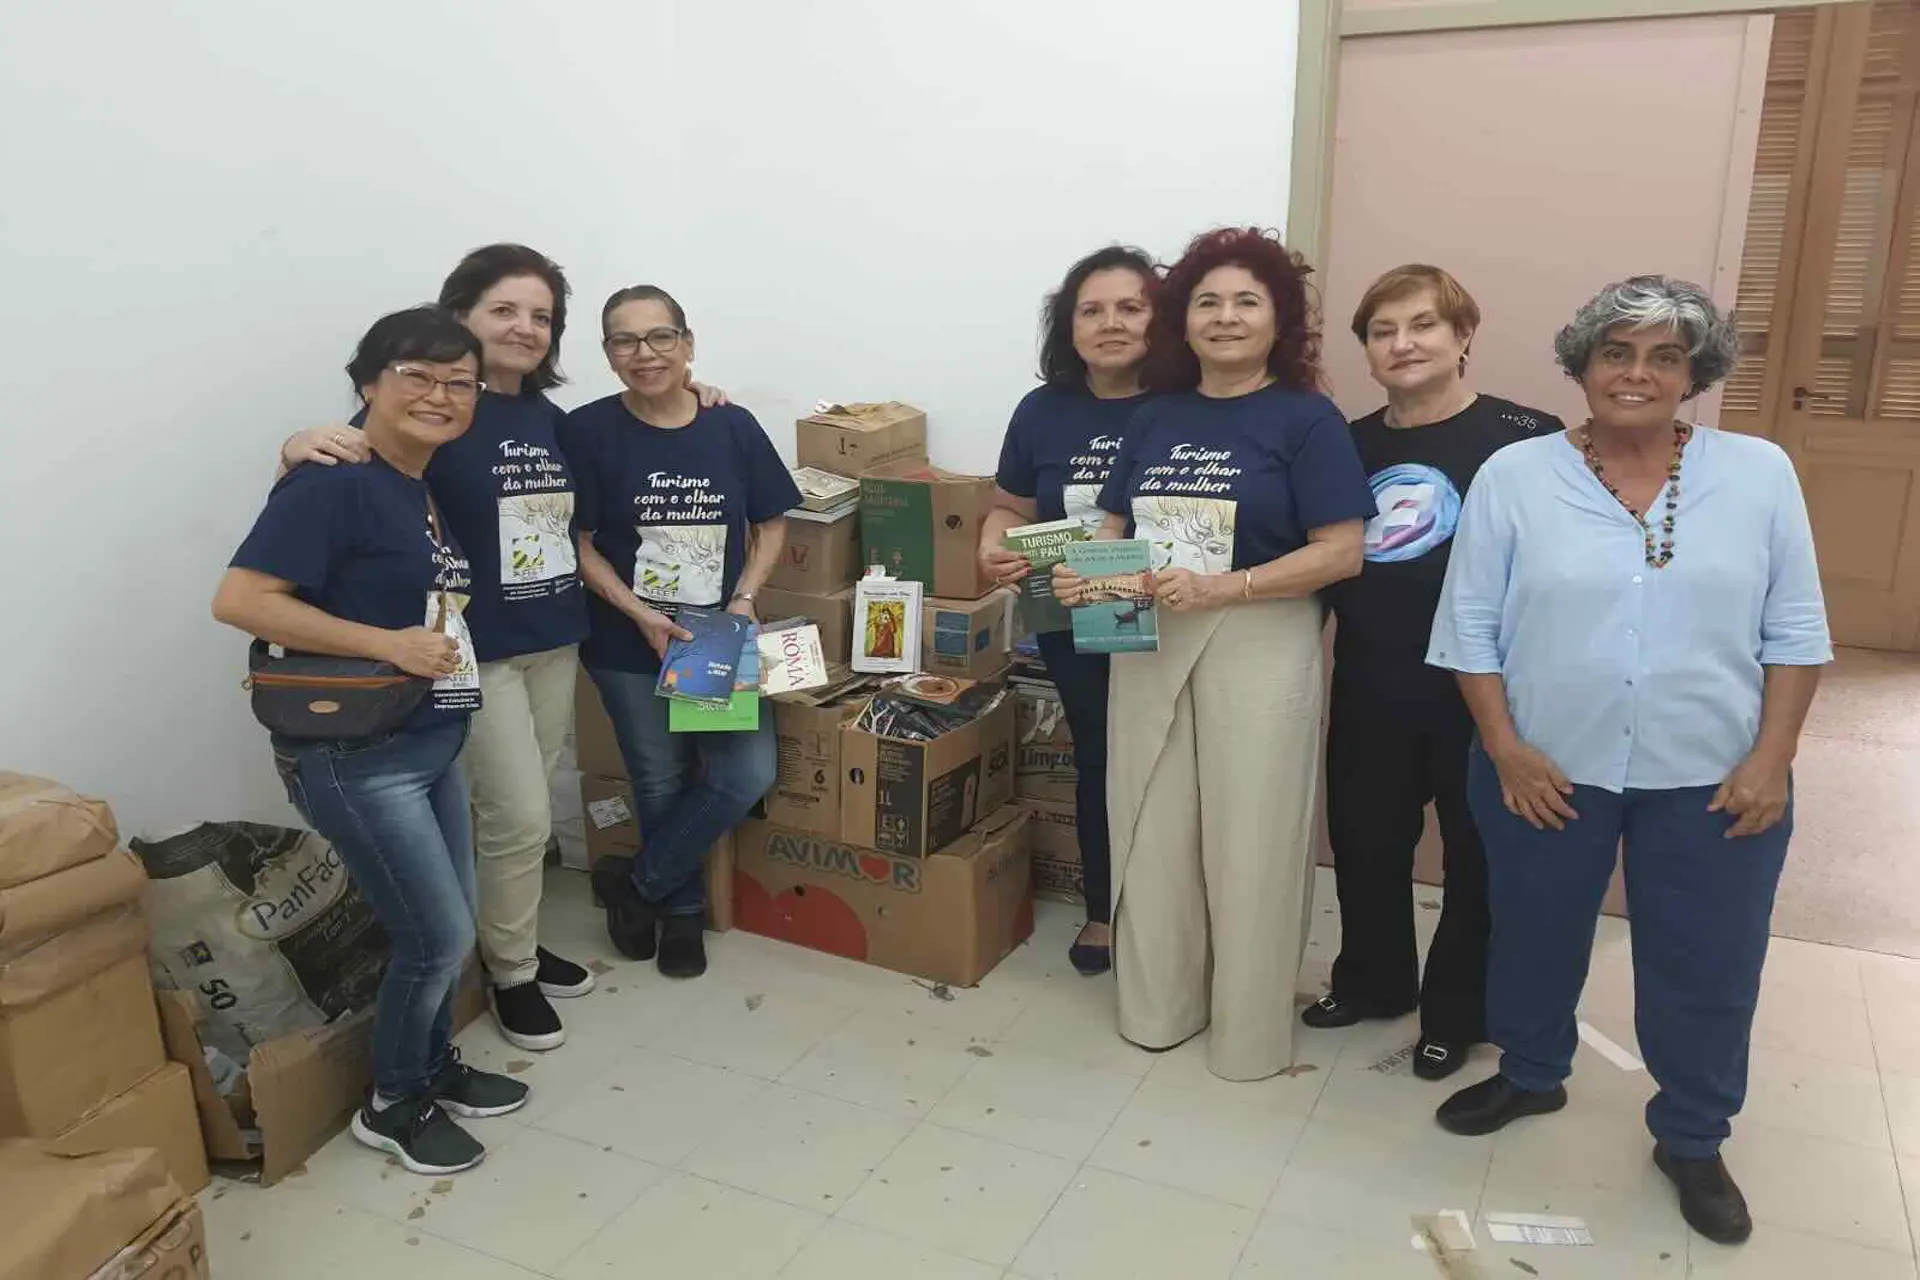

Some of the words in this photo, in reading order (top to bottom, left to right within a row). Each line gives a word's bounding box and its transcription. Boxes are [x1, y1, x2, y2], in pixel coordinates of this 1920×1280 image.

[1170, 443, 1231, 461] Turismo
[492, 464, 522, 475] com
[524, 463, 532, 472] o
[1070, 456, 1102, 466] com
[1144, 466, 1176, 476] com
[1179, 466, 1190, 475] o
[1193, 461, 1242, 477] olhar
[503, 477, 521, 490] da
[525, 472, 567, 489] mulher
[648, 472, 710, 488] Turismo
[1073, 466, 1096, 480] da
[1140, 477, 1162, 490] da
[1165, 476, 1231, 493] mulher
[634, 495, 668, 504] com
[671, 495, 679, 504] o
[684, 489, 725, 504] olhar
[640, 507, 663, 520] da
[667, 505, 722, 520] mulher
[1020, 531, 1073, 549] TURISMO
[781, 632, 805, 686] ROMA
[814, 769, 825, 784] 6
[199, 979, 239, 1010] 50
